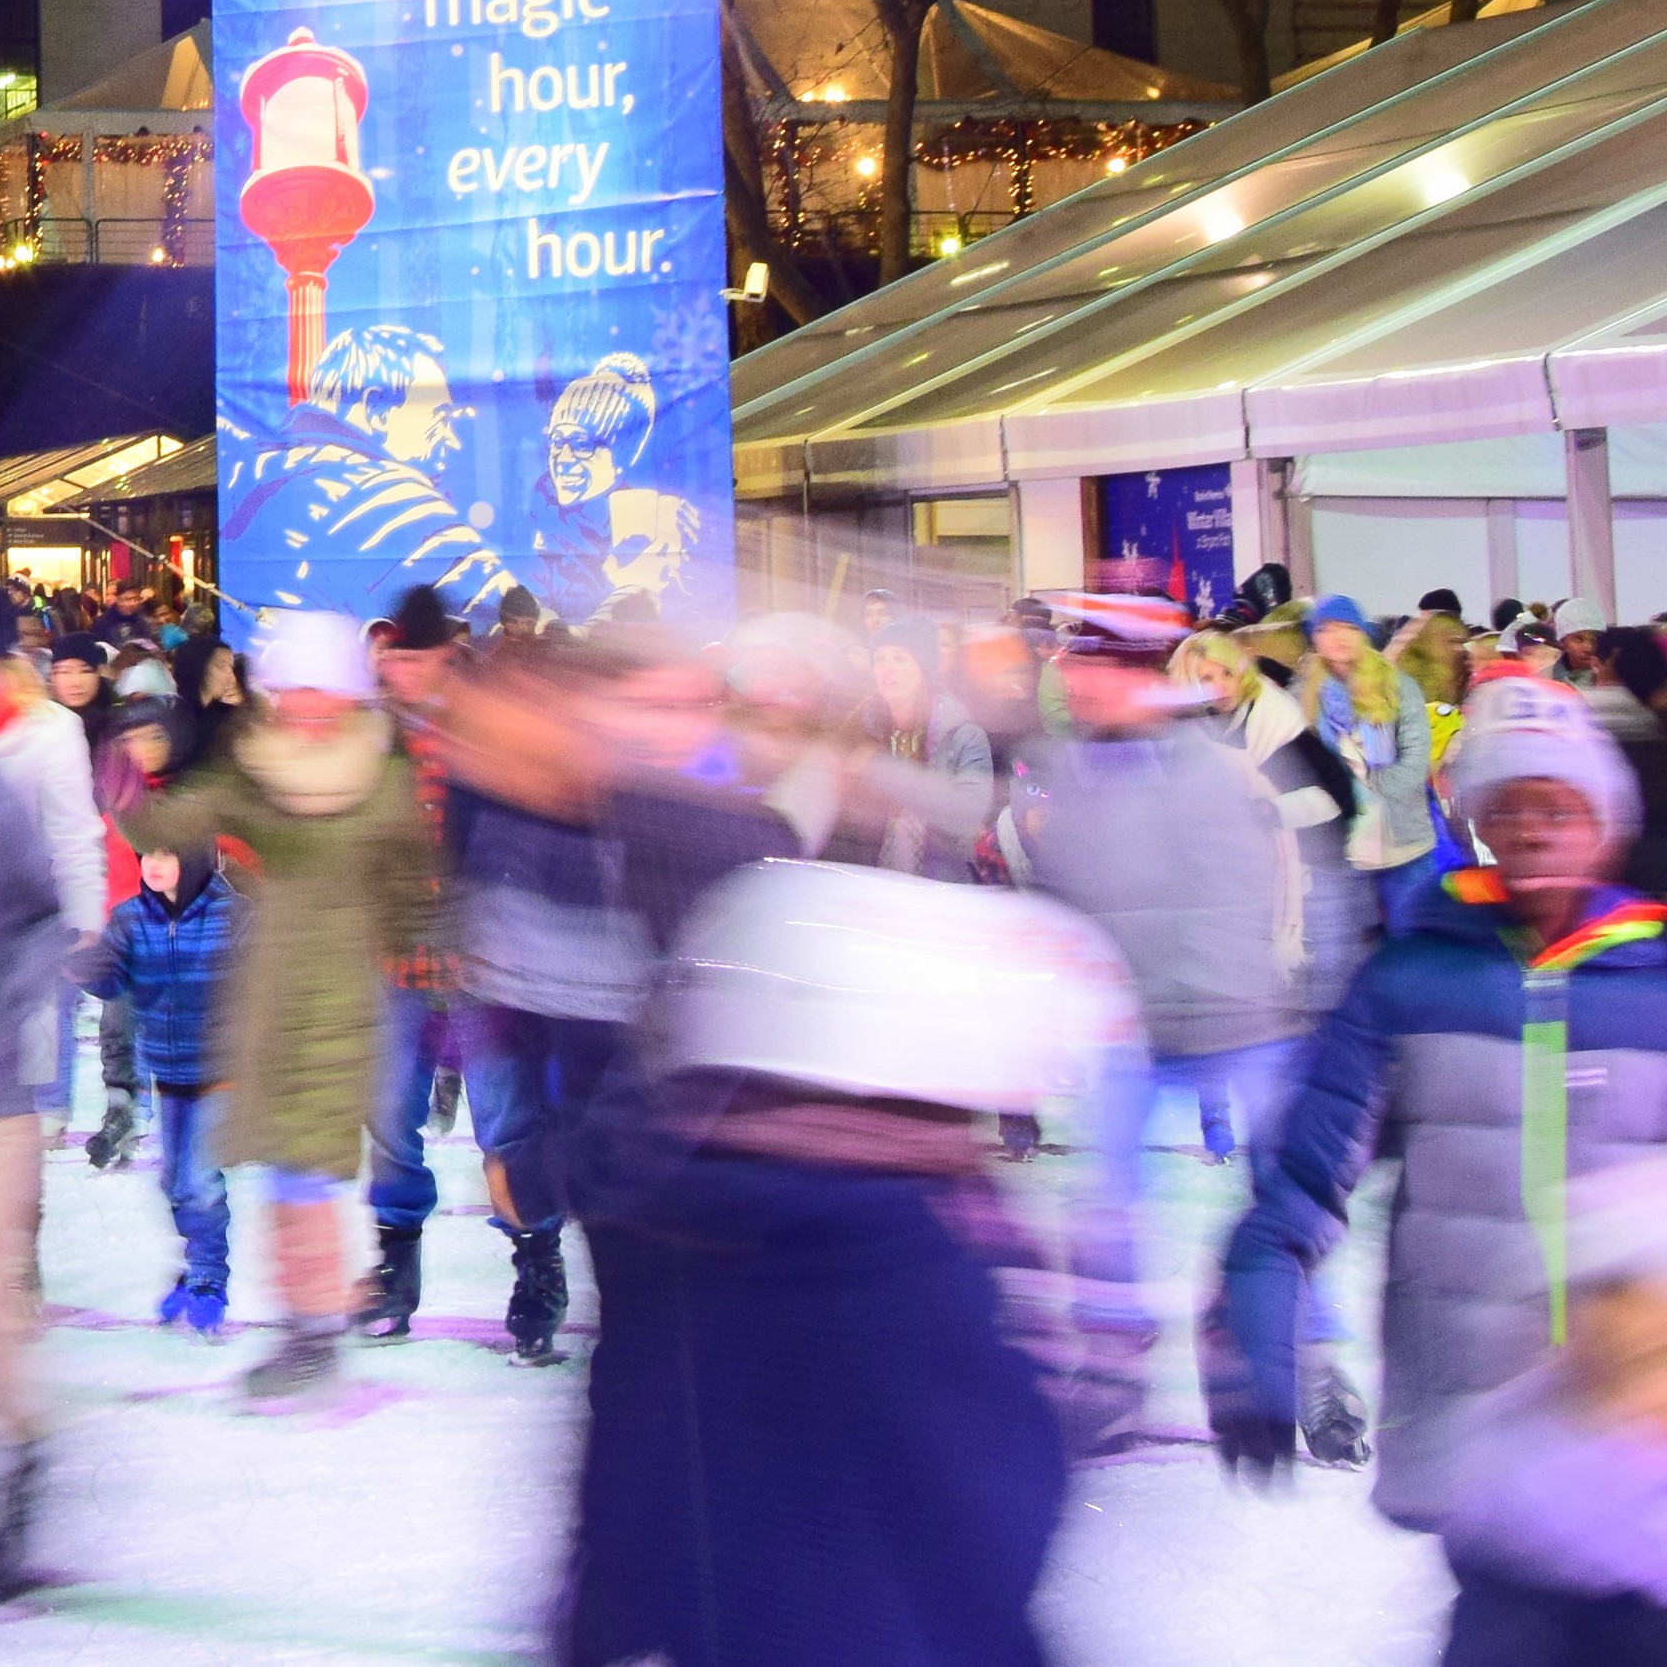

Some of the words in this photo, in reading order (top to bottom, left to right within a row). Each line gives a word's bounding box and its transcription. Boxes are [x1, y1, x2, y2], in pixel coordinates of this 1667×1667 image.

[490, 52, 634, 115] hour,
[447, 142, 609, 204] every
[527, 217, 672, 279] hour.
